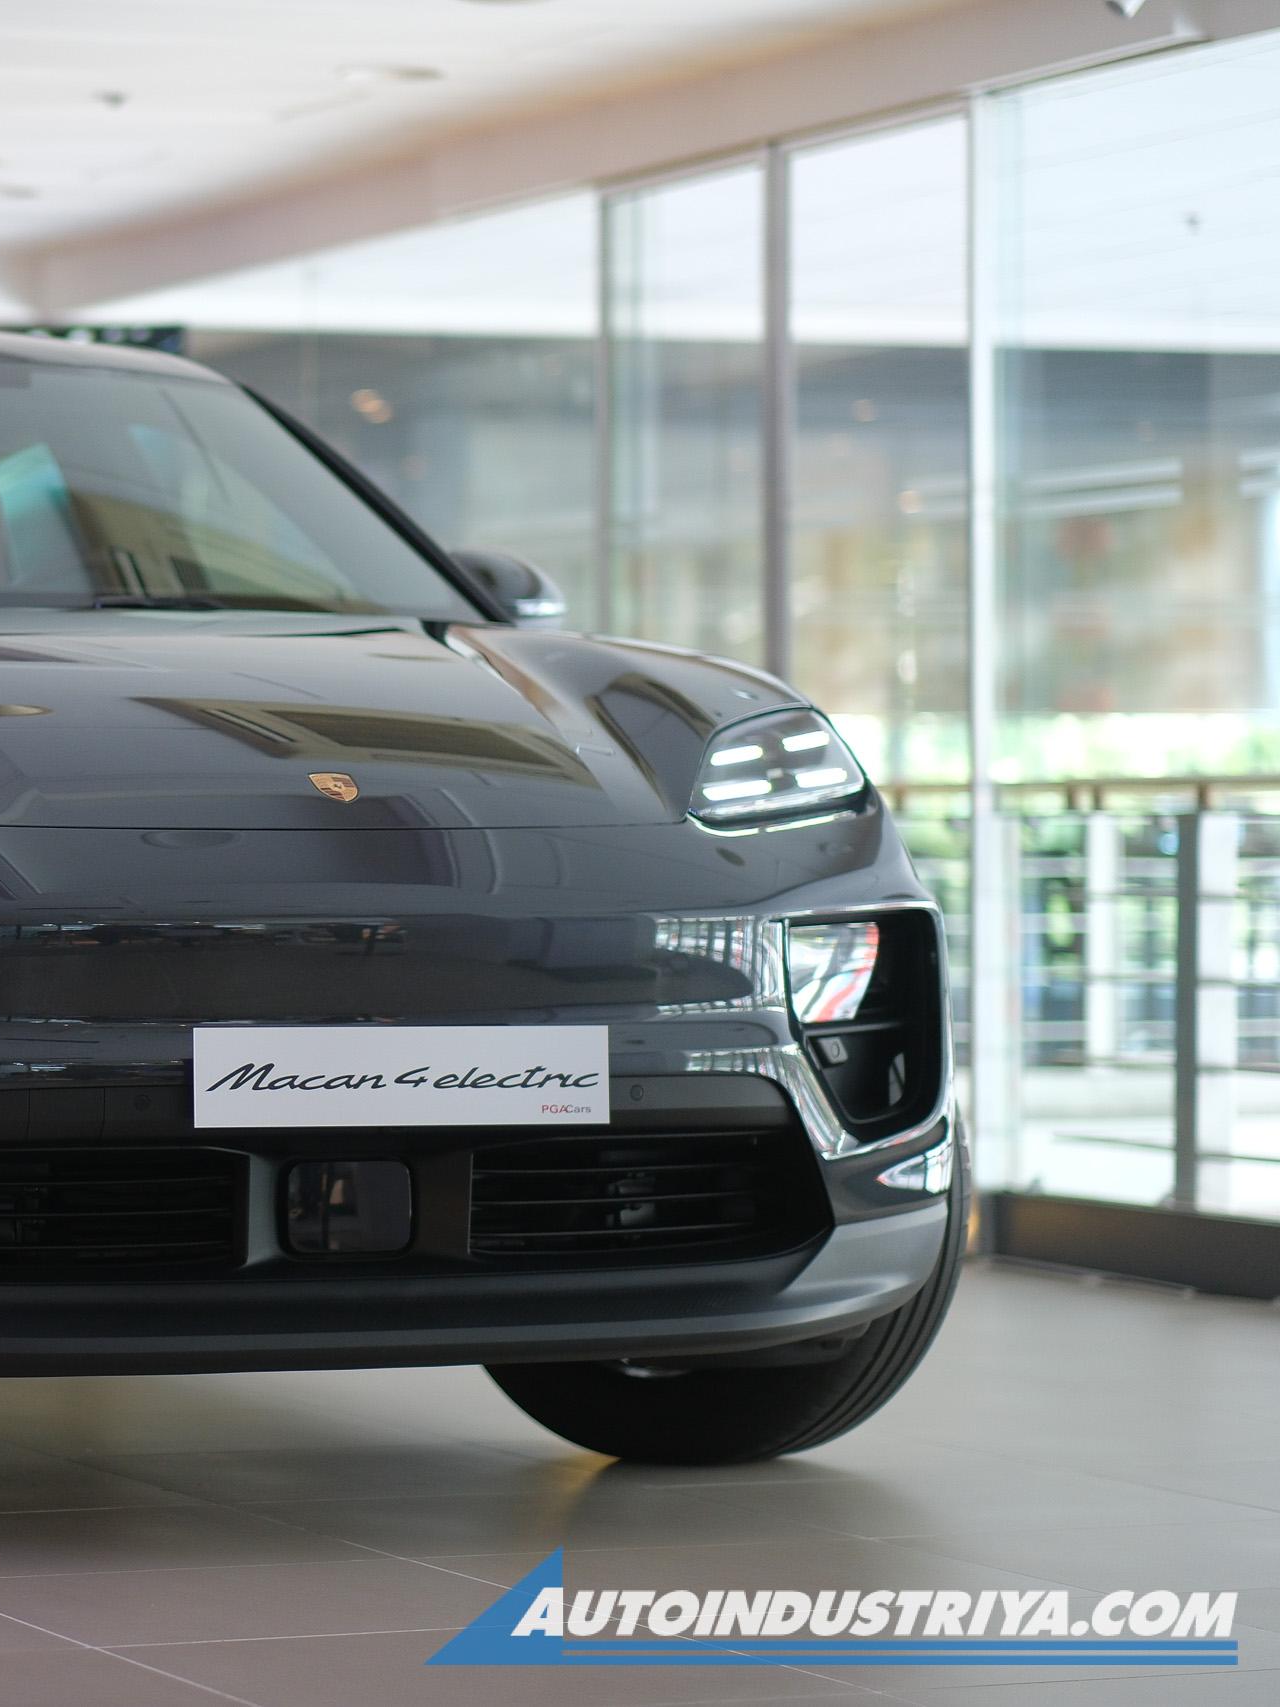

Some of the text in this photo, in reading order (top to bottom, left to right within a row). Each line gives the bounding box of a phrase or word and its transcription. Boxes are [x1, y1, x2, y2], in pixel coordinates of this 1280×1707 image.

[204, 1063, 600, 1092] Macan 4 electric
